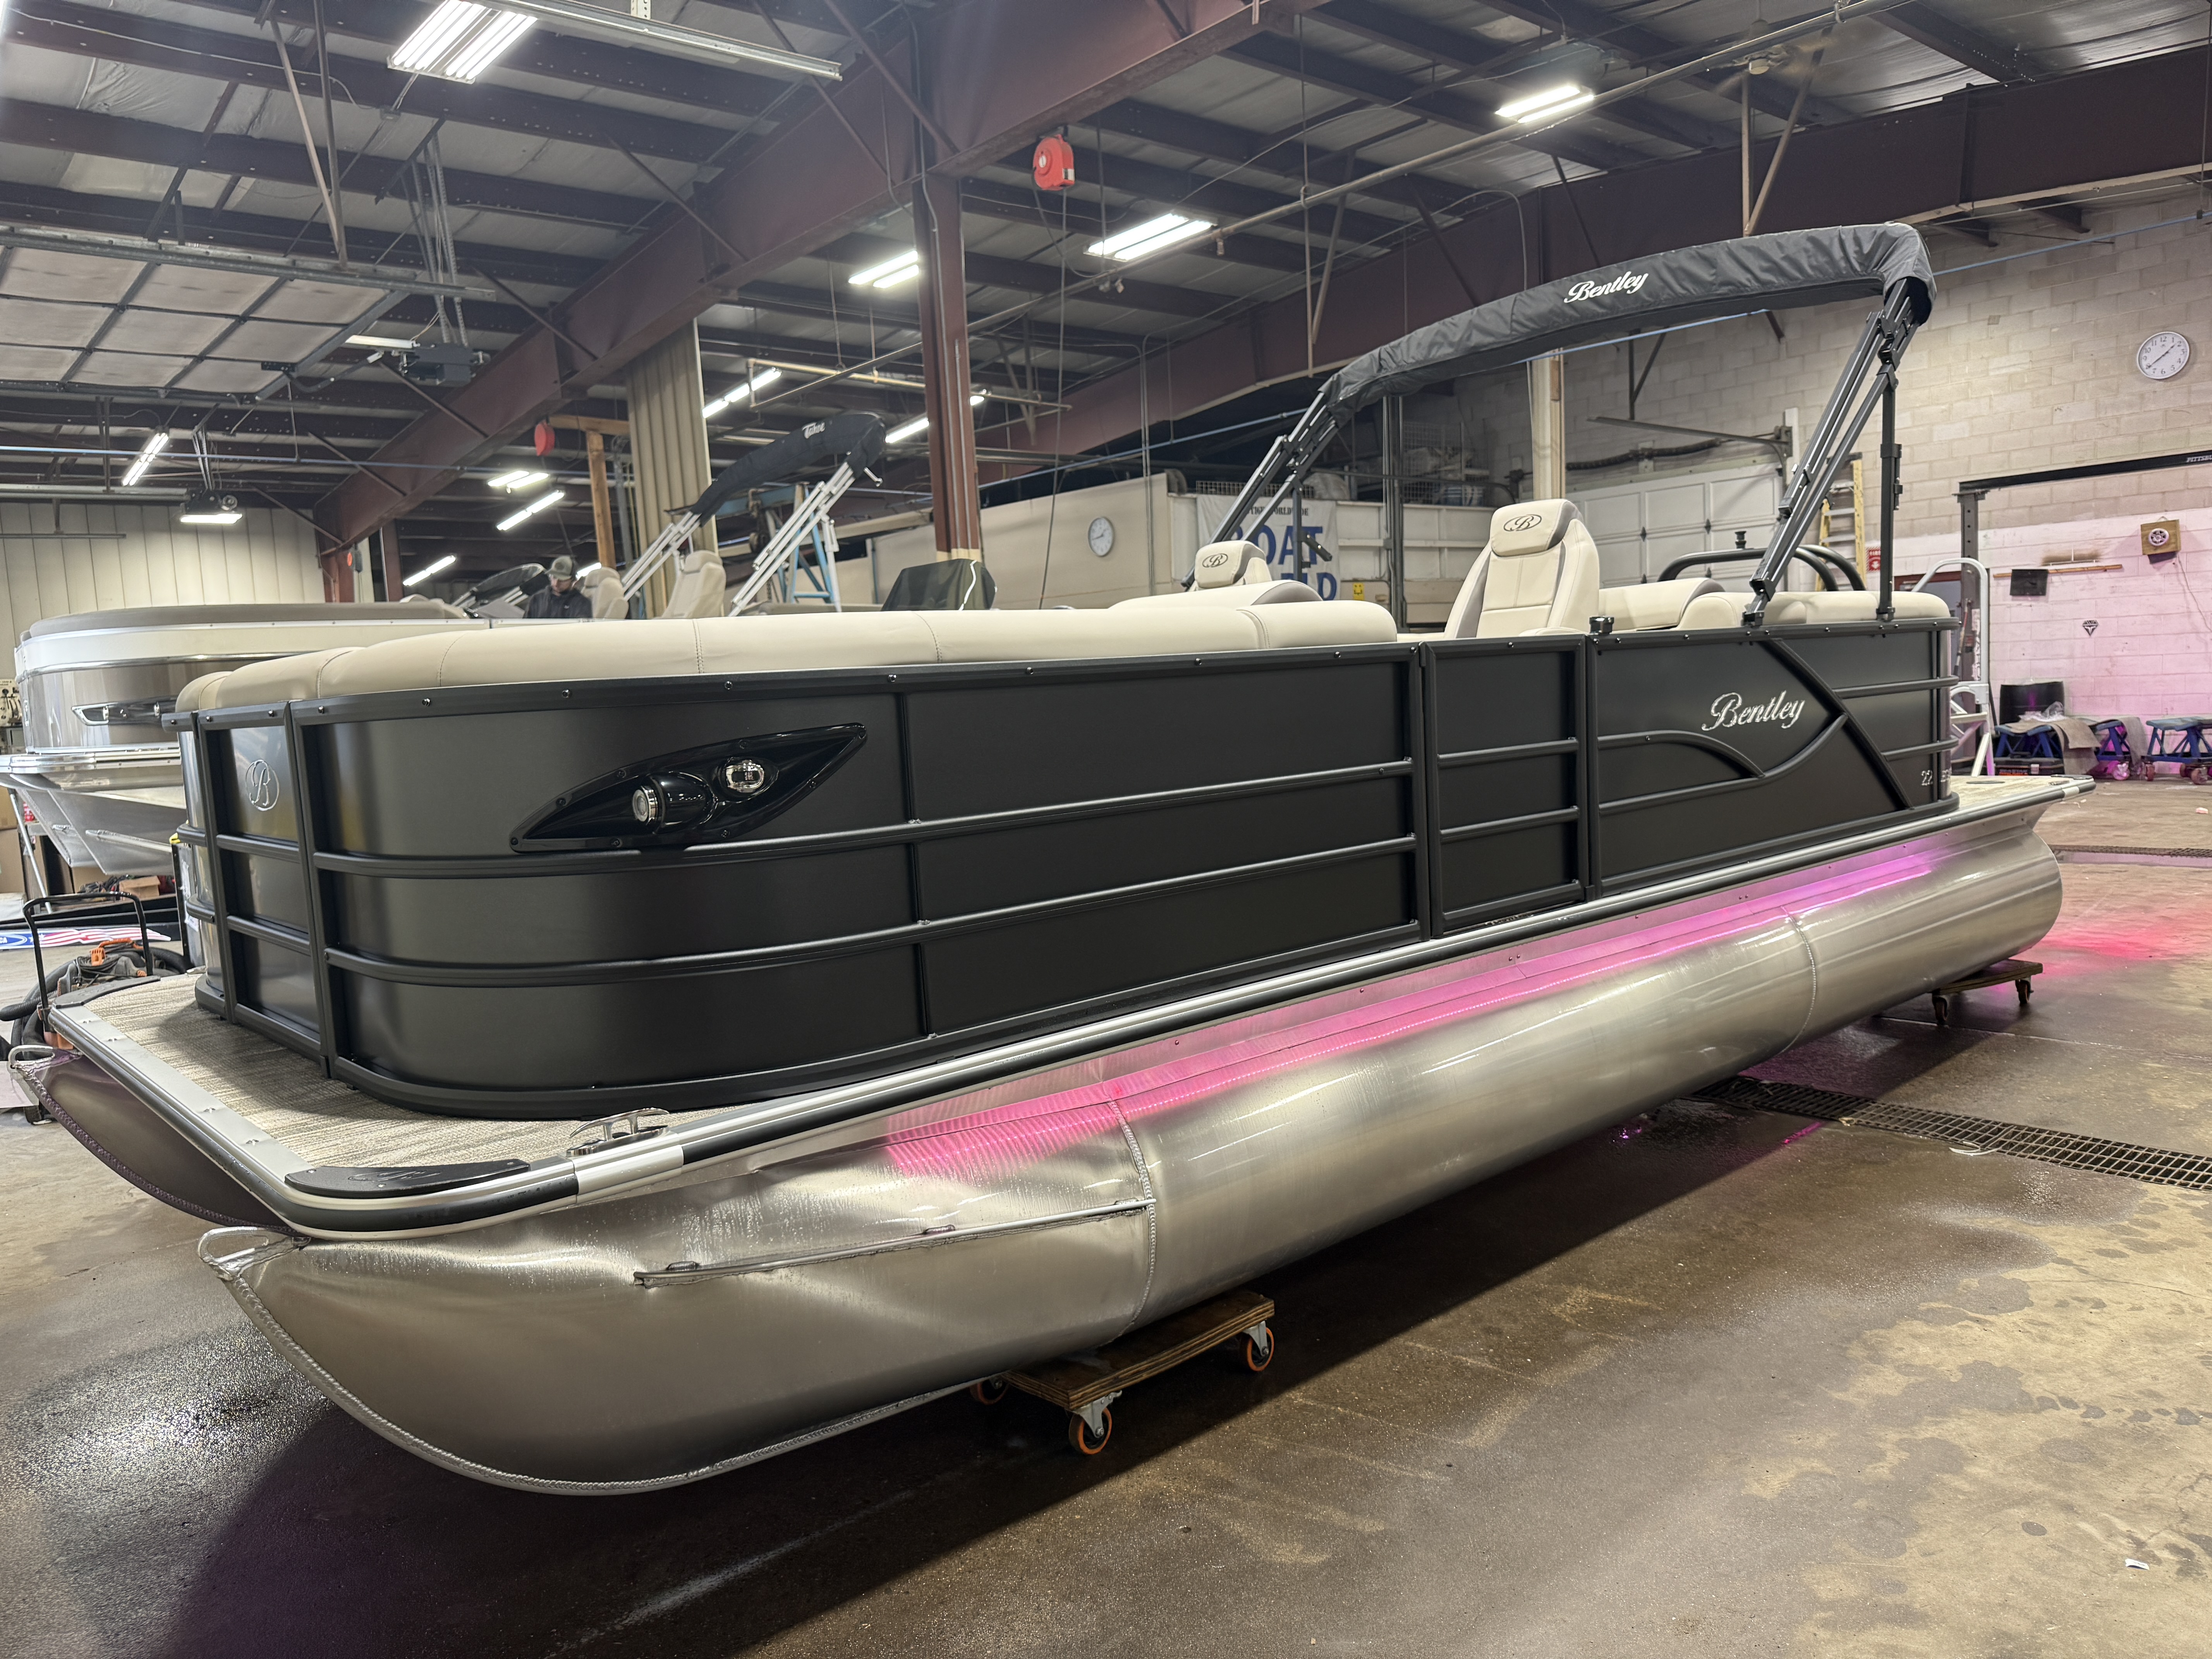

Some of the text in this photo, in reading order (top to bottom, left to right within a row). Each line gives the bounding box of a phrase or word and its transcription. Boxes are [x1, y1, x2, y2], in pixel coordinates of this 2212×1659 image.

[1564, 271, 1649, 303] Bentley
[802, 422, 825, 438] Tahoe
[1701, 690, 1805, 731] Bentley
